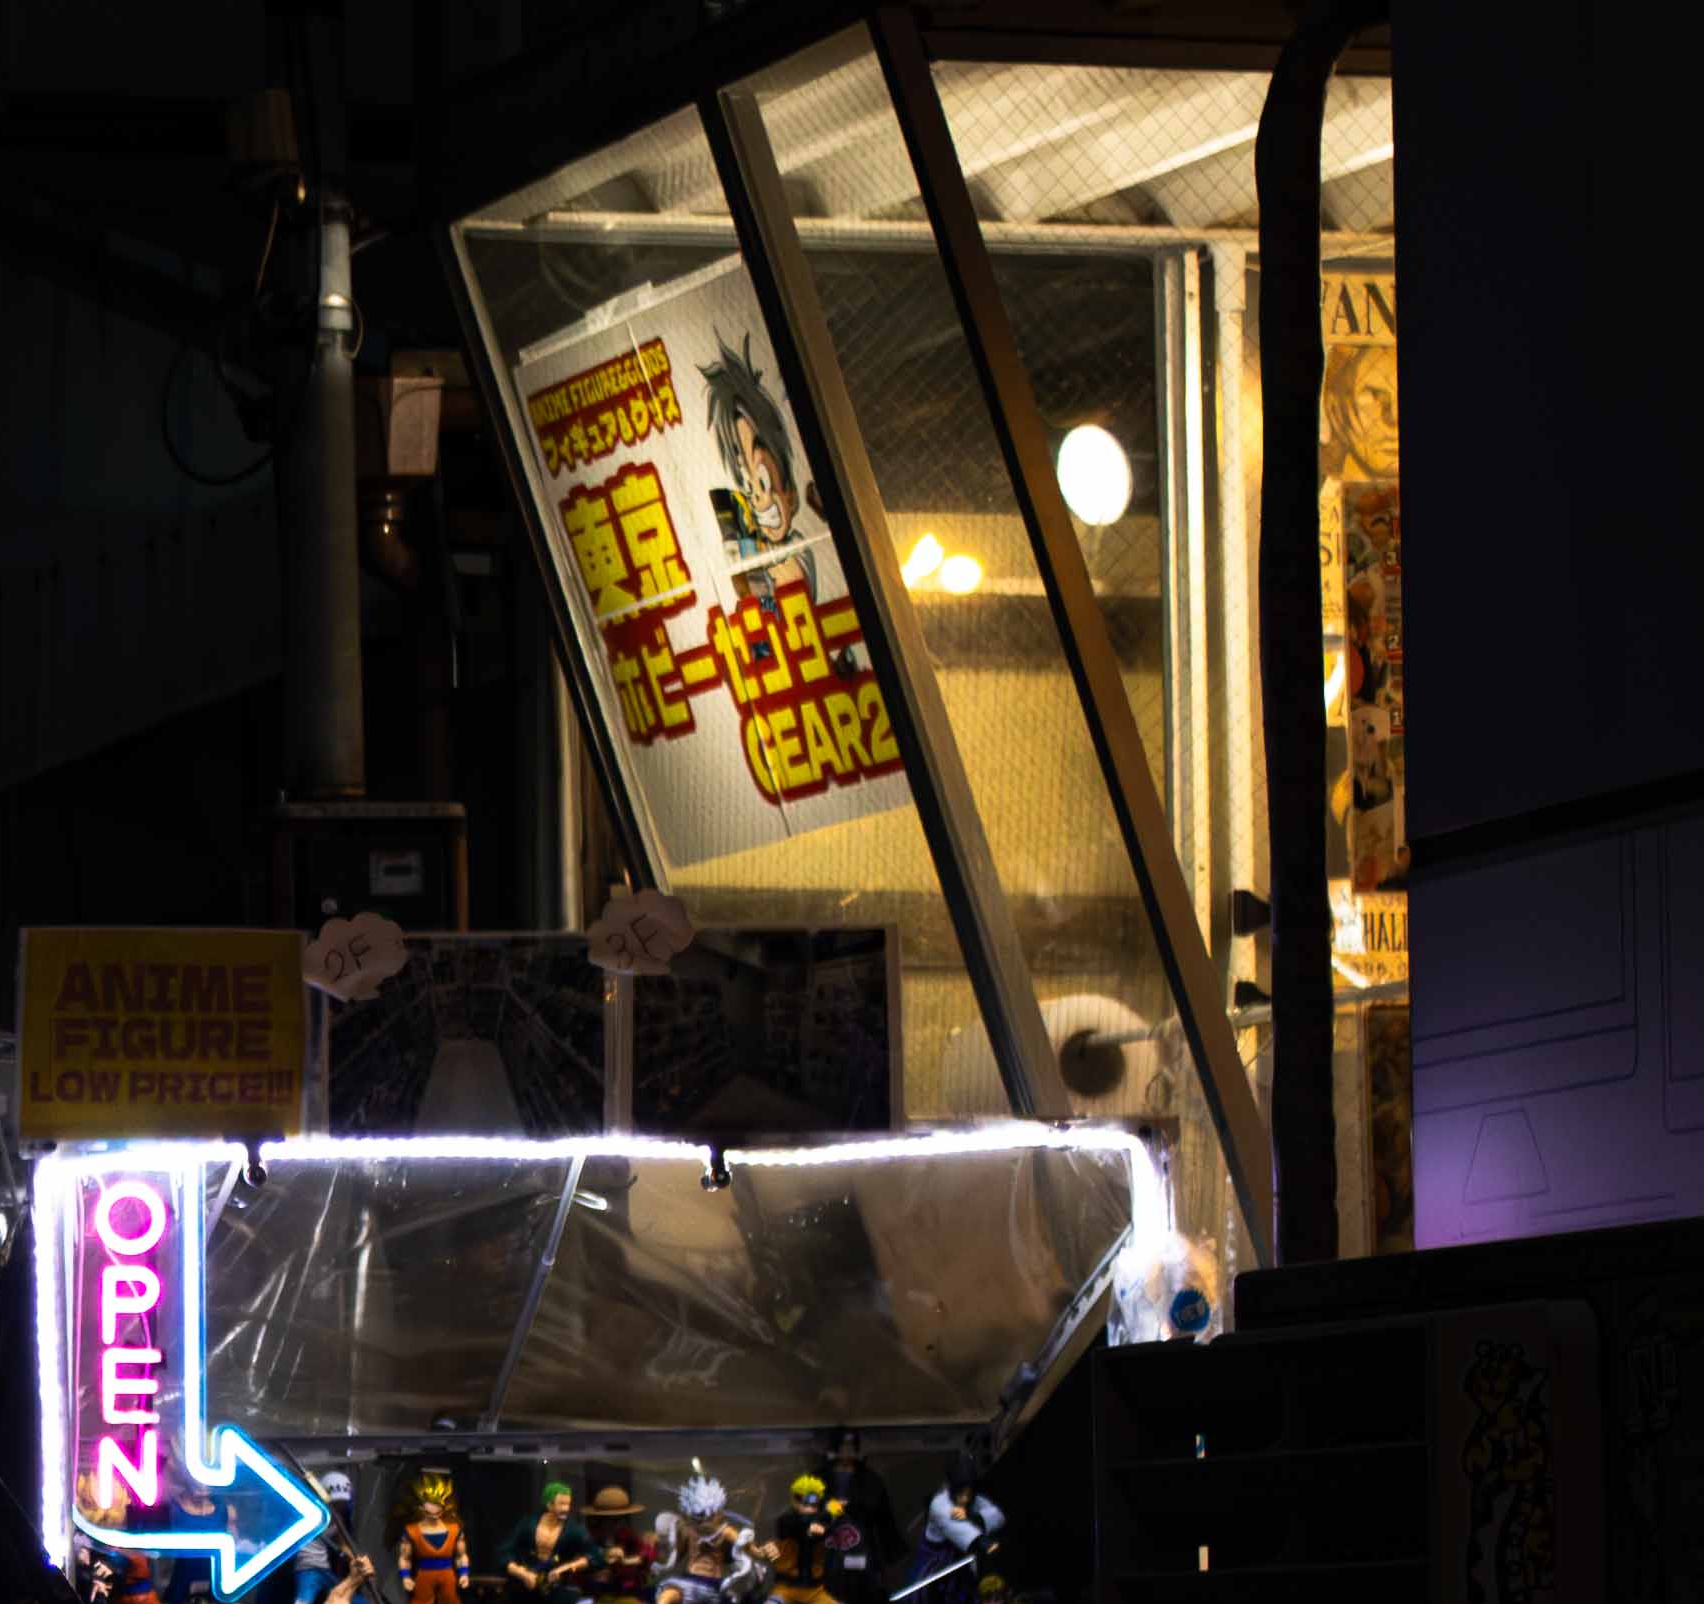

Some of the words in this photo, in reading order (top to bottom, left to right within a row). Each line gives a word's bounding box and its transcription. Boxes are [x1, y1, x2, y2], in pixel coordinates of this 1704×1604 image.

[1321, 280, 1396, 336] AN
[561, 468, 693, 625] 東京
[745, 680, 901, 797] GEAR2
[323, 932, 373, 981] 2F
[55, 959, 274, 1013] ANIME
[51, 1017, 274, 1062] FIGURE
[28, 1070, 123, 1104] LOW
[95, 1180, 166, 1510] OPEN
